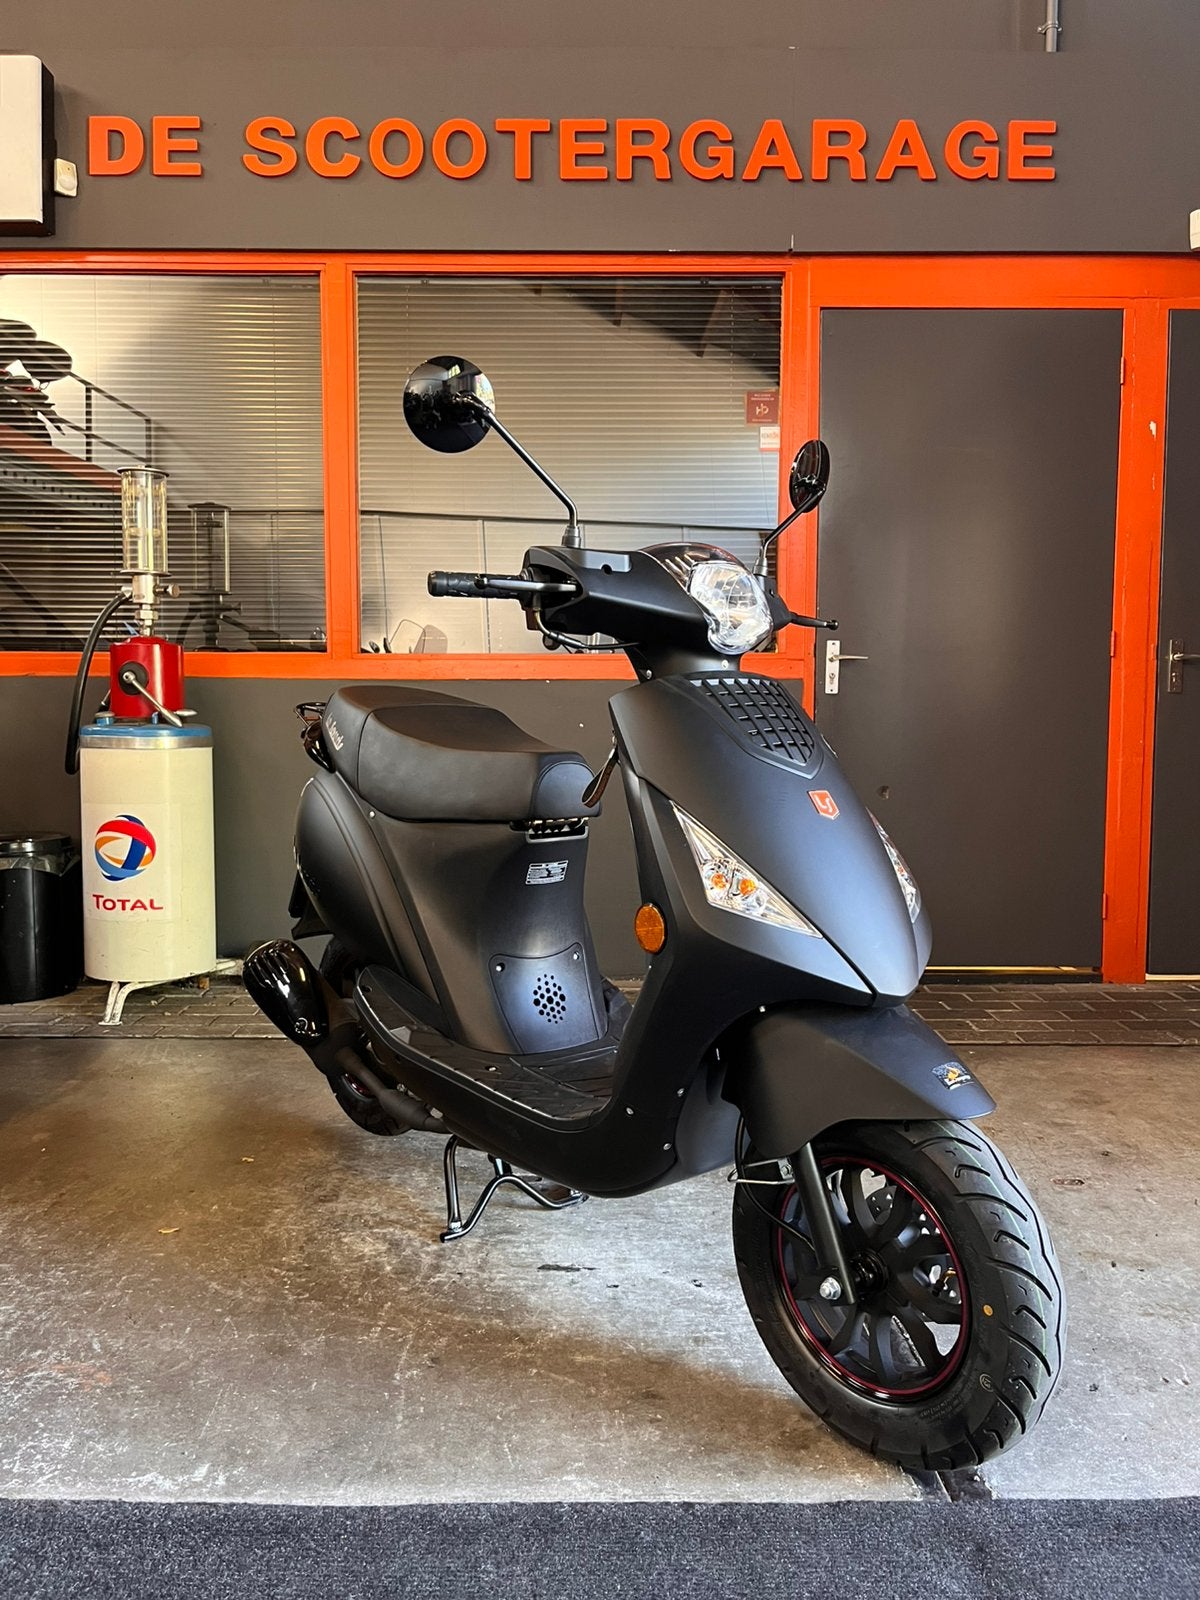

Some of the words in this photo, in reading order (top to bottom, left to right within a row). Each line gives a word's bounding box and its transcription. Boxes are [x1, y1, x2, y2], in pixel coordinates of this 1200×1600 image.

[89, 117, 202, 176] DE
[242, 117, 1056, 181] SCOOTERGARAGE
[92, 893, 164, 911] TOTAL
